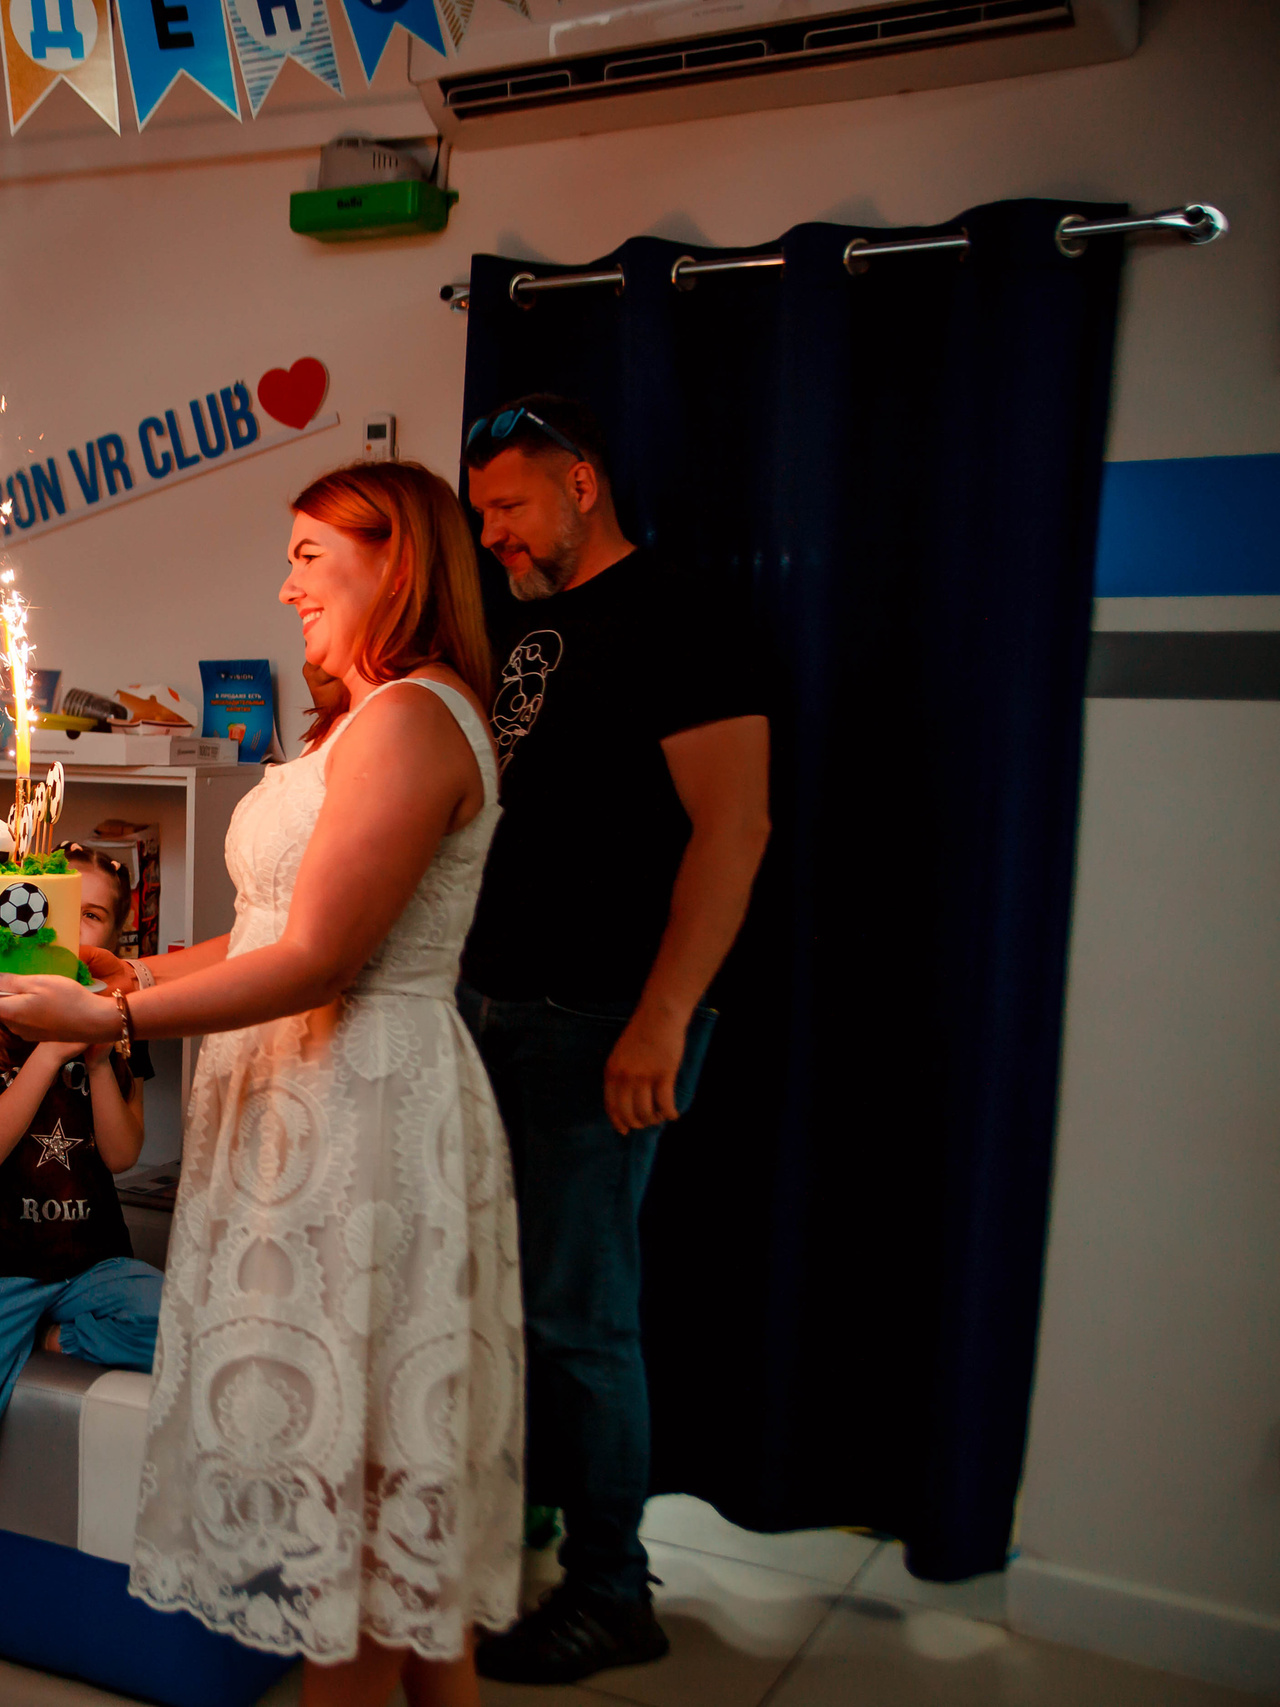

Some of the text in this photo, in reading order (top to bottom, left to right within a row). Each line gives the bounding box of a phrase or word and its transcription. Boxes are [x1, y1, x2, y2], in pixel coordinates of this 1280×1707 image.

[68, 433, 133, 505] VR
[138, 381, 260, 480] CLUB
[19, 1197, 91, 1223] ROLL
